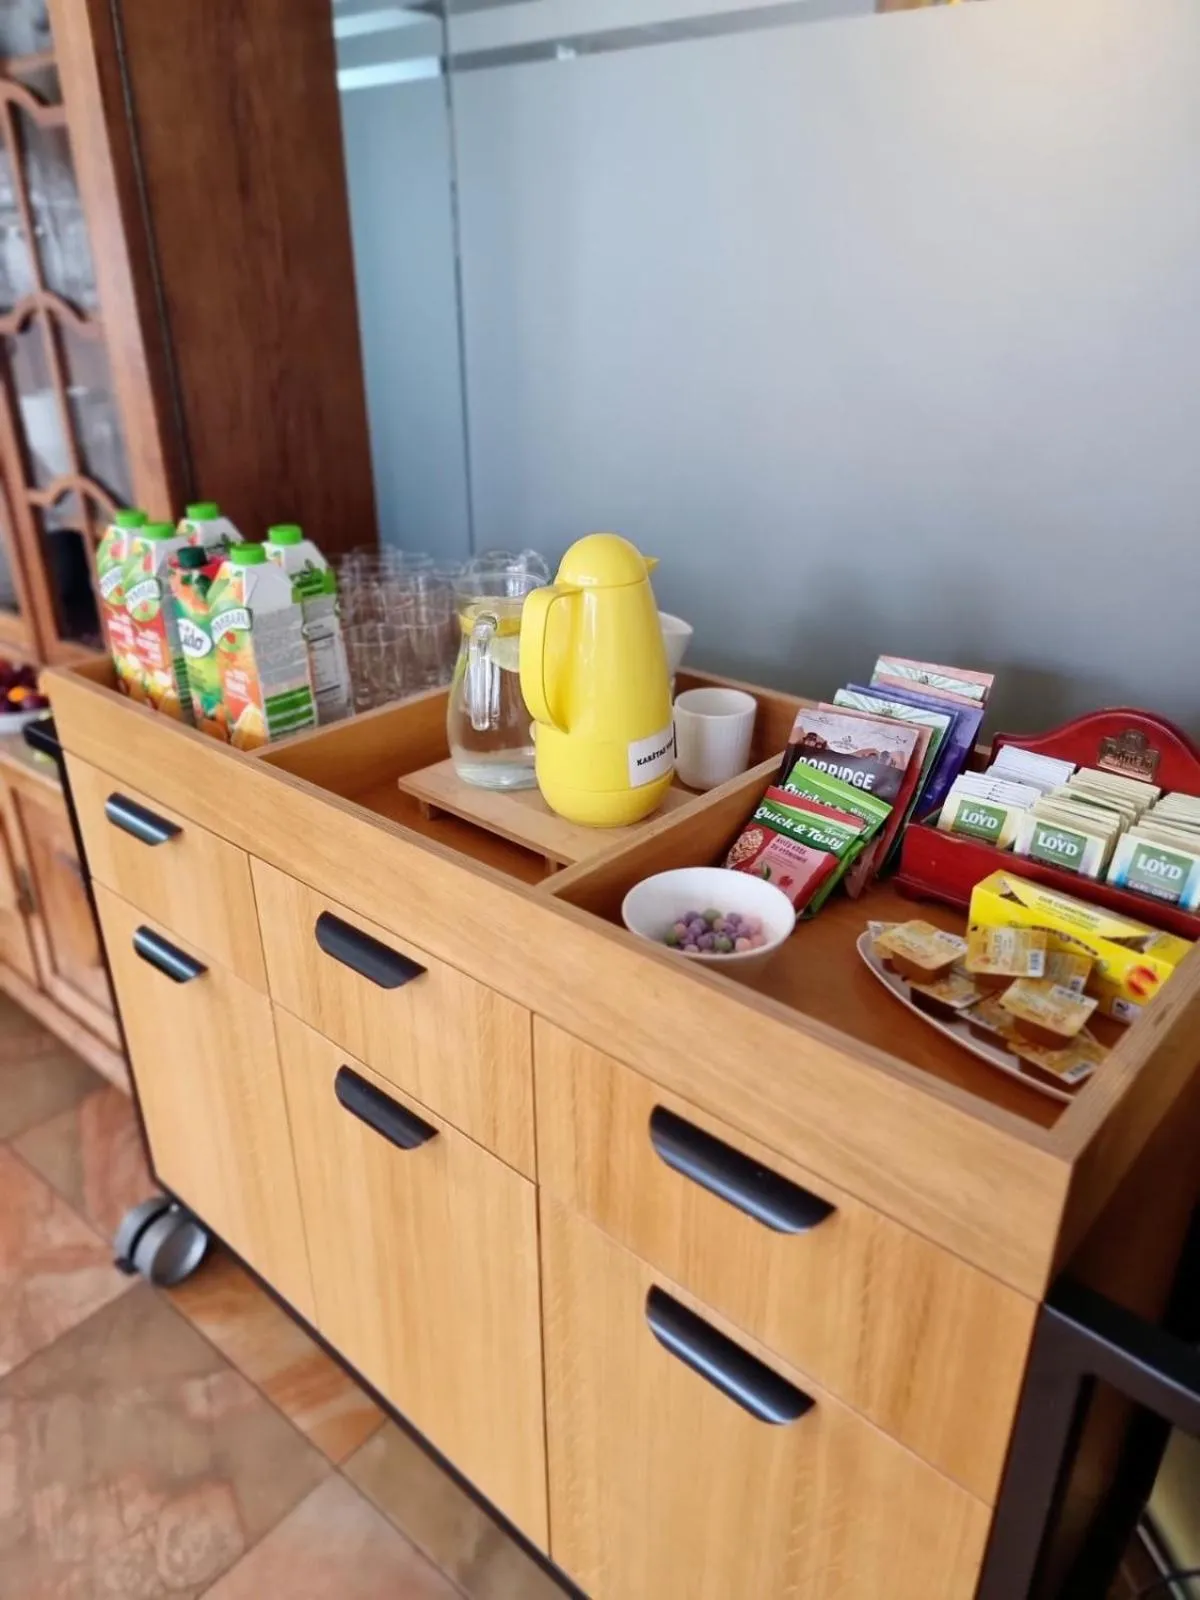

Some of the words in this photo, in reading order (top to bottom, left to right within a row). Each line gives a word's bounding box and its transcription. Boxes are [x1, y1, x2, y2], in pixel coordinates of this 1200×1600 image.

[754, 807, 792, 829] Quick
[793, 822, 808, 834] &
[807, 828, 844, 850] Tasty
[961, 809, 998, 829] LOYD
[1038, 832, 1078, 856] LOYD
[1137, 854, 1182, 879] LOYD
